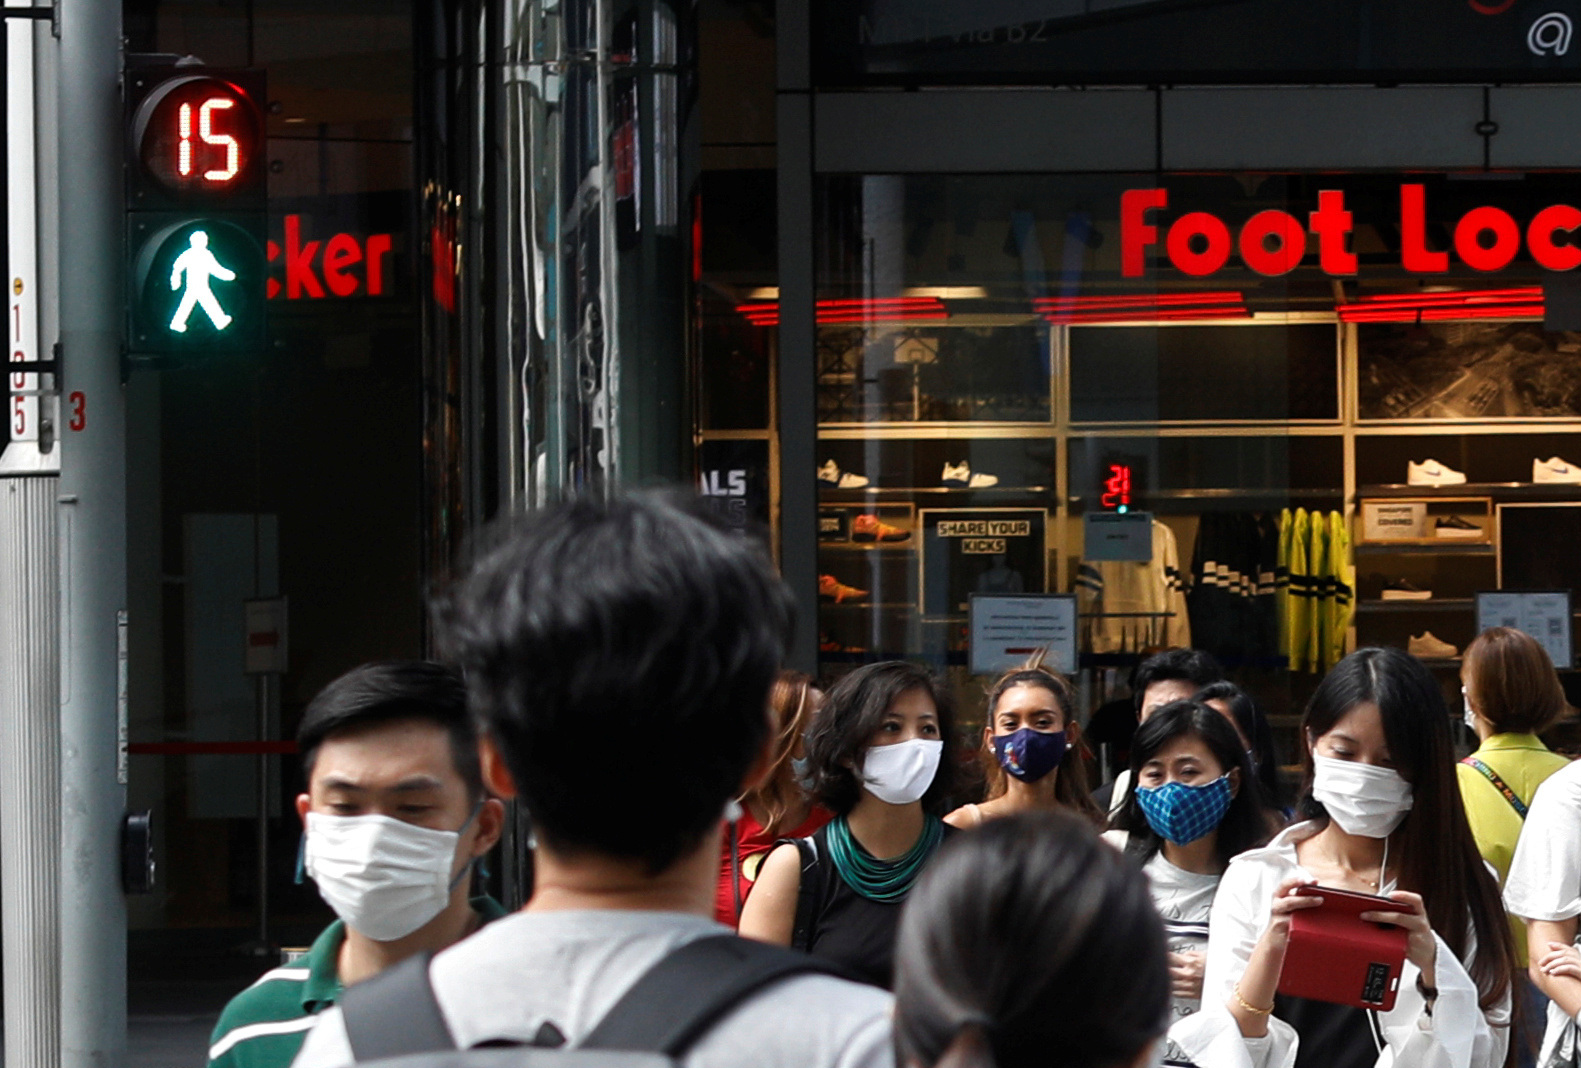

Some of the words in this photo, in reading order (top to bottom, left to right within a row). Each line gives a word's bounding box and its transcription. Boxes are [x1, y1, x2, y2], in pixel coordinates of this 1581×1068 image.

[1527, 11, 1573, 56] @
[177, 97, 240, 182] 15
[1121, 187, 1358, 277] Foot
[69, 391, 87, 432] 3
[939, 521, 986, 536] SHARE
[988, 520, 1030, 536] YOUR
[962, 539, 1005, 552] KICKS
